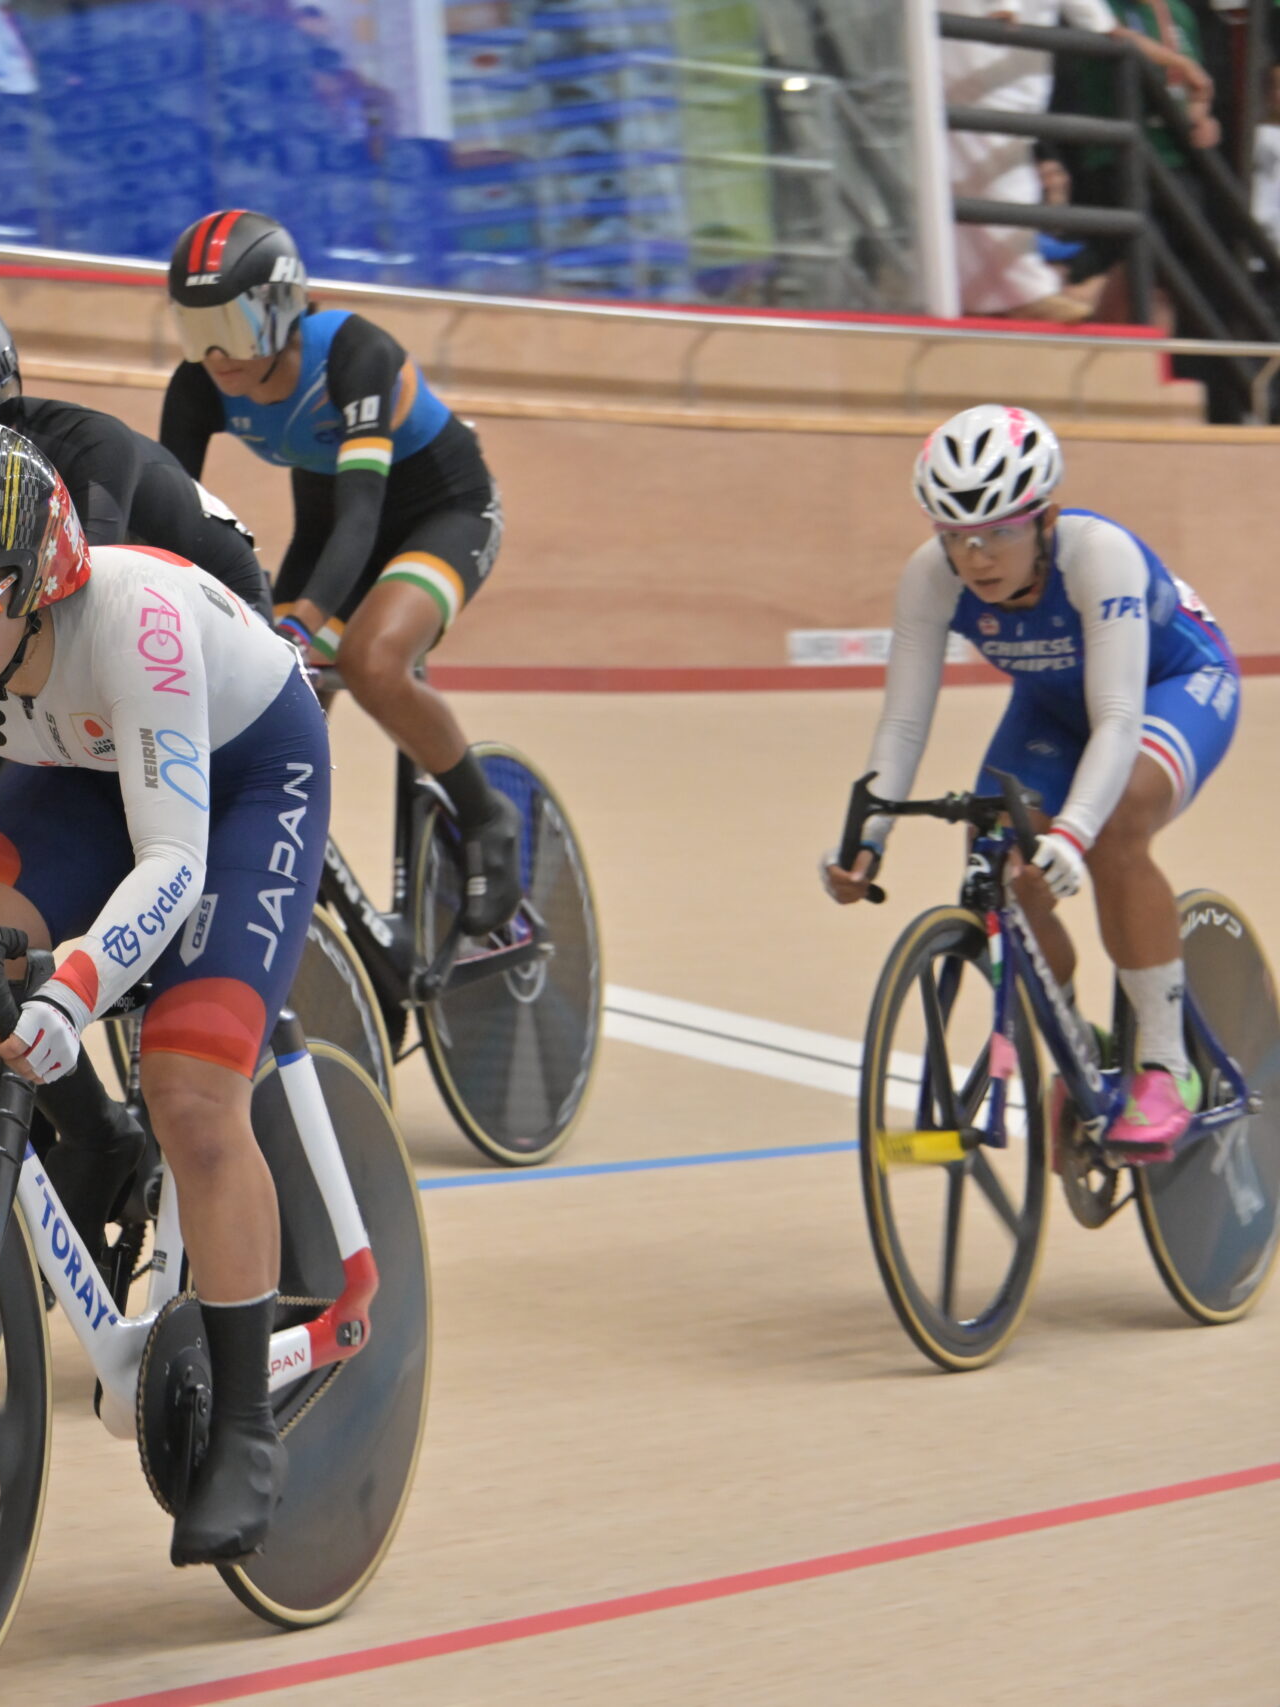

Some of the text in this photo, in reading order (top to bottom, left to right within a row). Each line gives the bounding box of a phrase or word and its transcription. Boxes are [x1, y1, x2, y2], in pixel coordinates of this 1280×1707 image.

[138, 727, 159, 789] KEIRIN
[141, 864, 192, 936] Cyclers
[246, 762, 314, 972] JAPAN
[40, 1186, 110, 1331] TORAY
[269, 1347, 306, 1377] PAN
